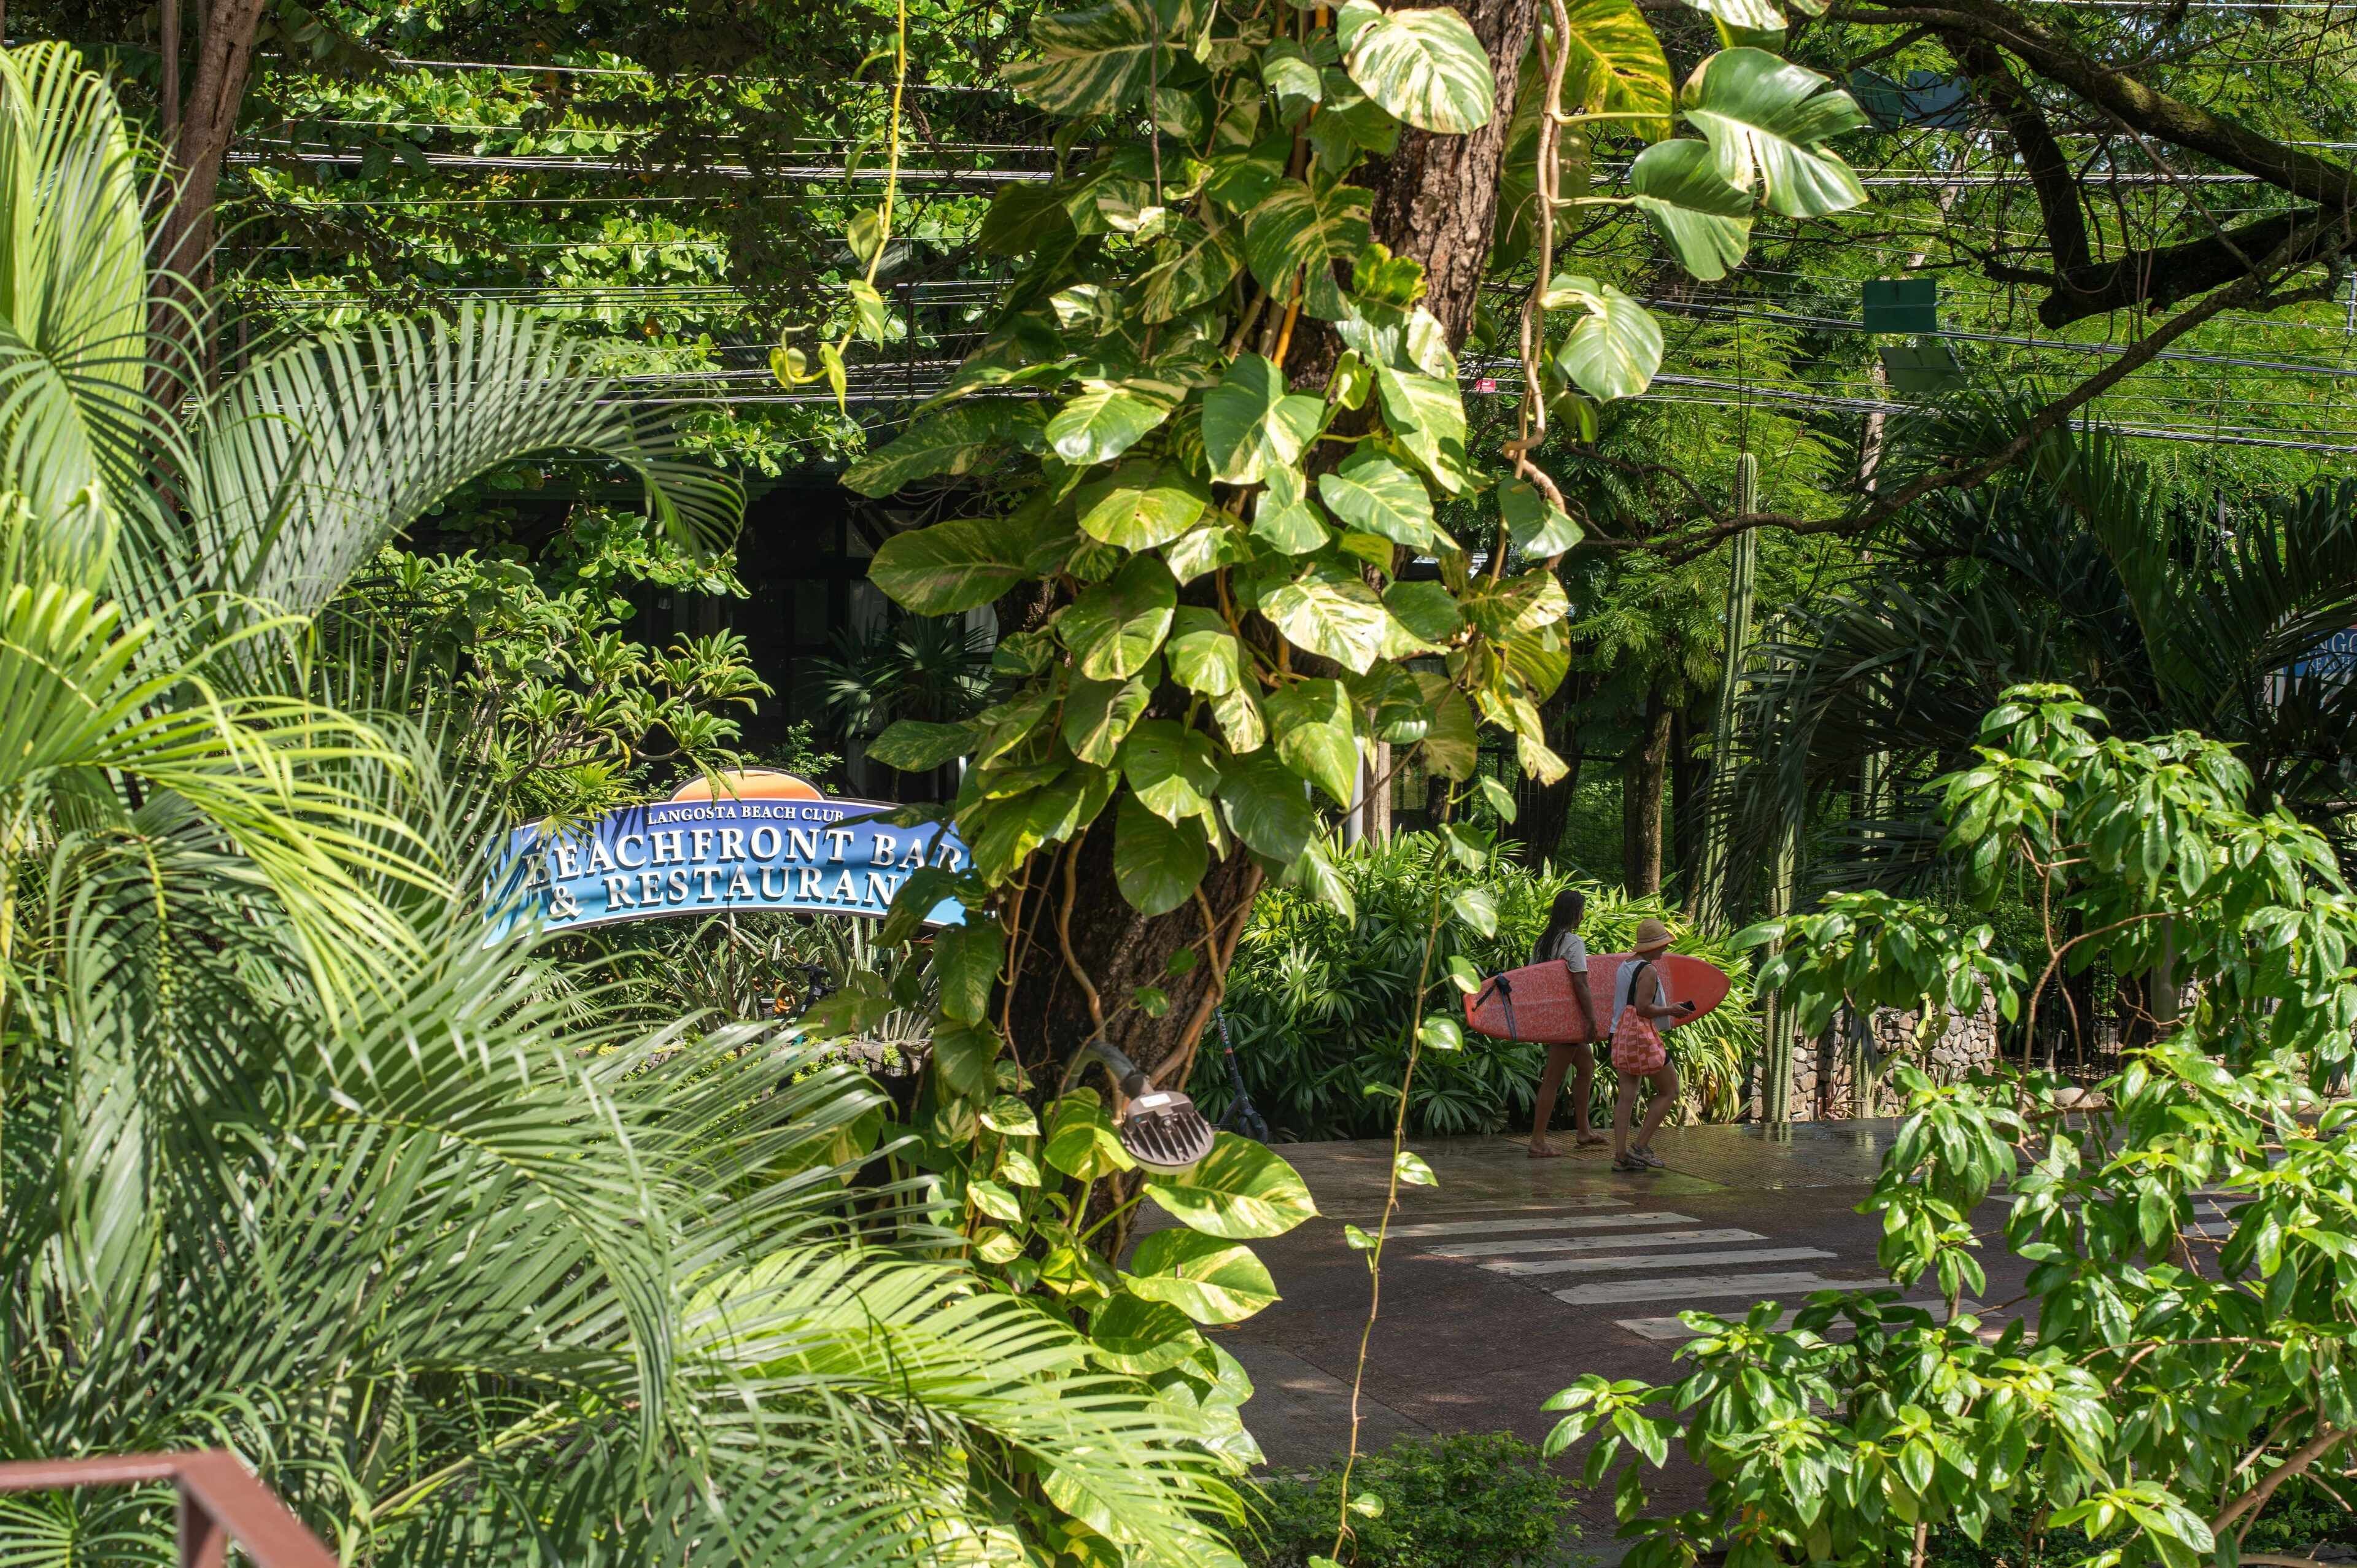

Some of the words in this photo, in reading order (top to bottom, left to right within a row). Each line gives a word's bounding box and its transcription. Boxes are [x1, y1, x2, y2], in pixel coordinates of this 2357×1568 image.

[647, 806, 737, 825] LANGOSTA
[741, 806, 796, 819] BEACH
[801, 807, 844, 822] CLUB
[870, 833, 962, 873] BAR
[550, 885, 584, 918] &
[603, 865, 911, 908] RESTAURAN
